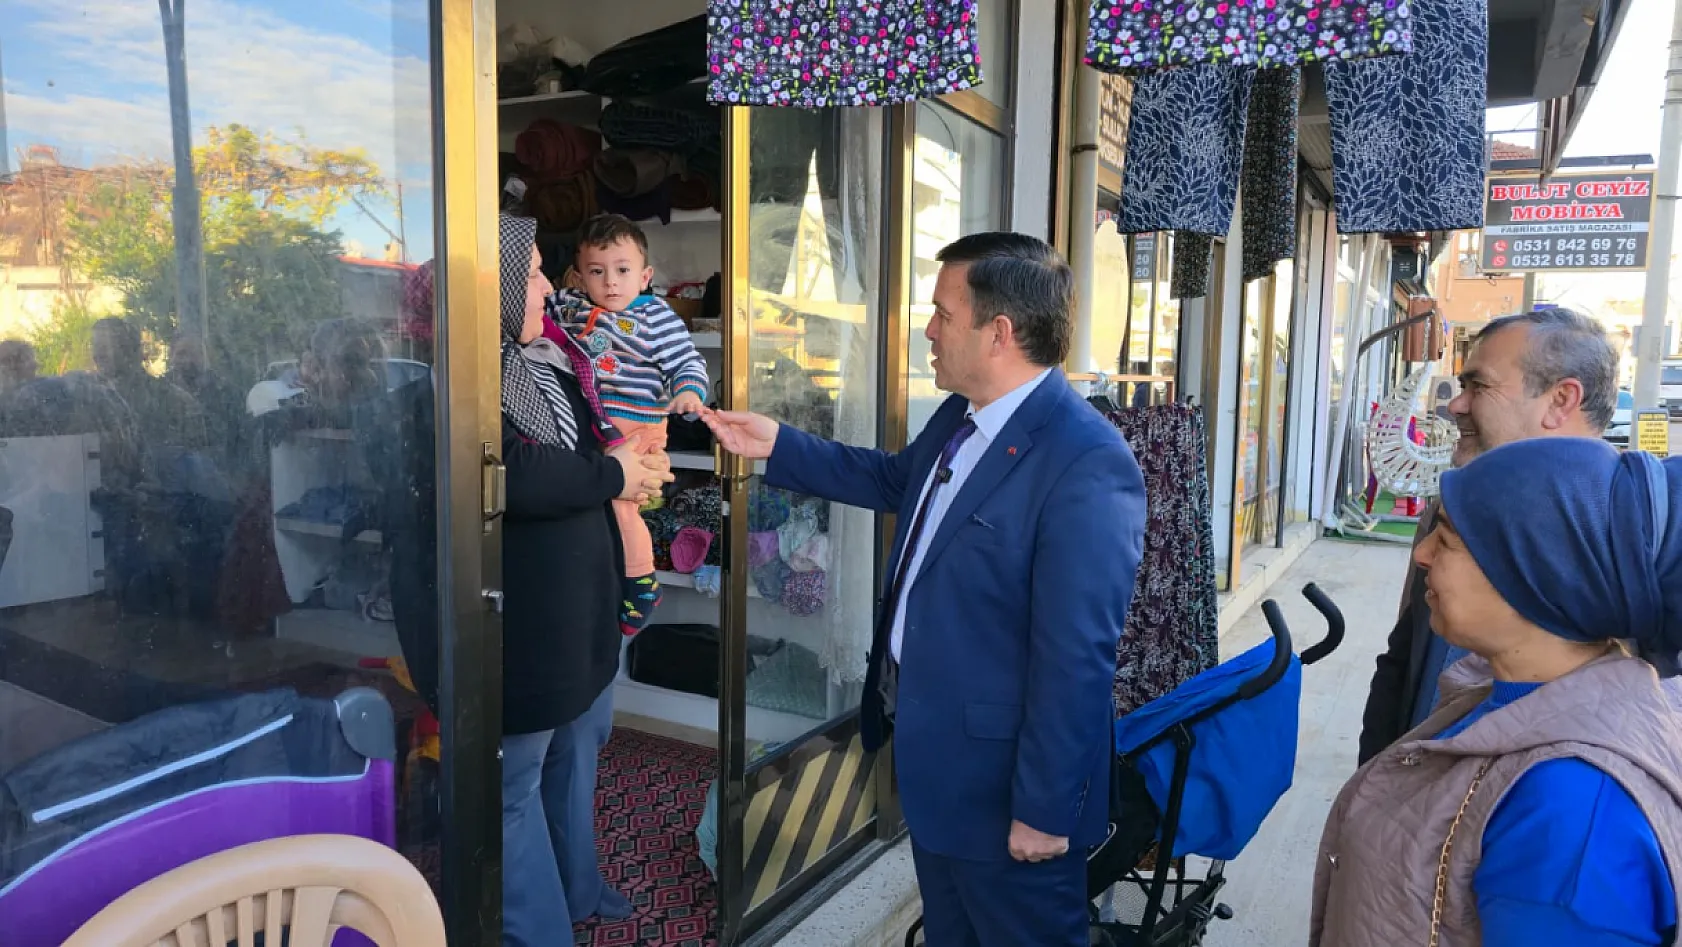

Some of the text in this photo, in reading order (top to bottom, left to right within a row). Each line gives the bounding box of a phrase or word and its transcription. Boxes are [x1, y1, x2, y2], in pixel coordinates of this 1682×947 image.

[1492, 183, 1570, 200] BULUT
[1511, 200, 1624, 221] MOBİLYA
[1500, 225, 1543, 233] FABRİKA
[1513, 238, 1636, 252] 0531 842 69 76
[1511, 253, 1635, 267] 0532 613 35 78
